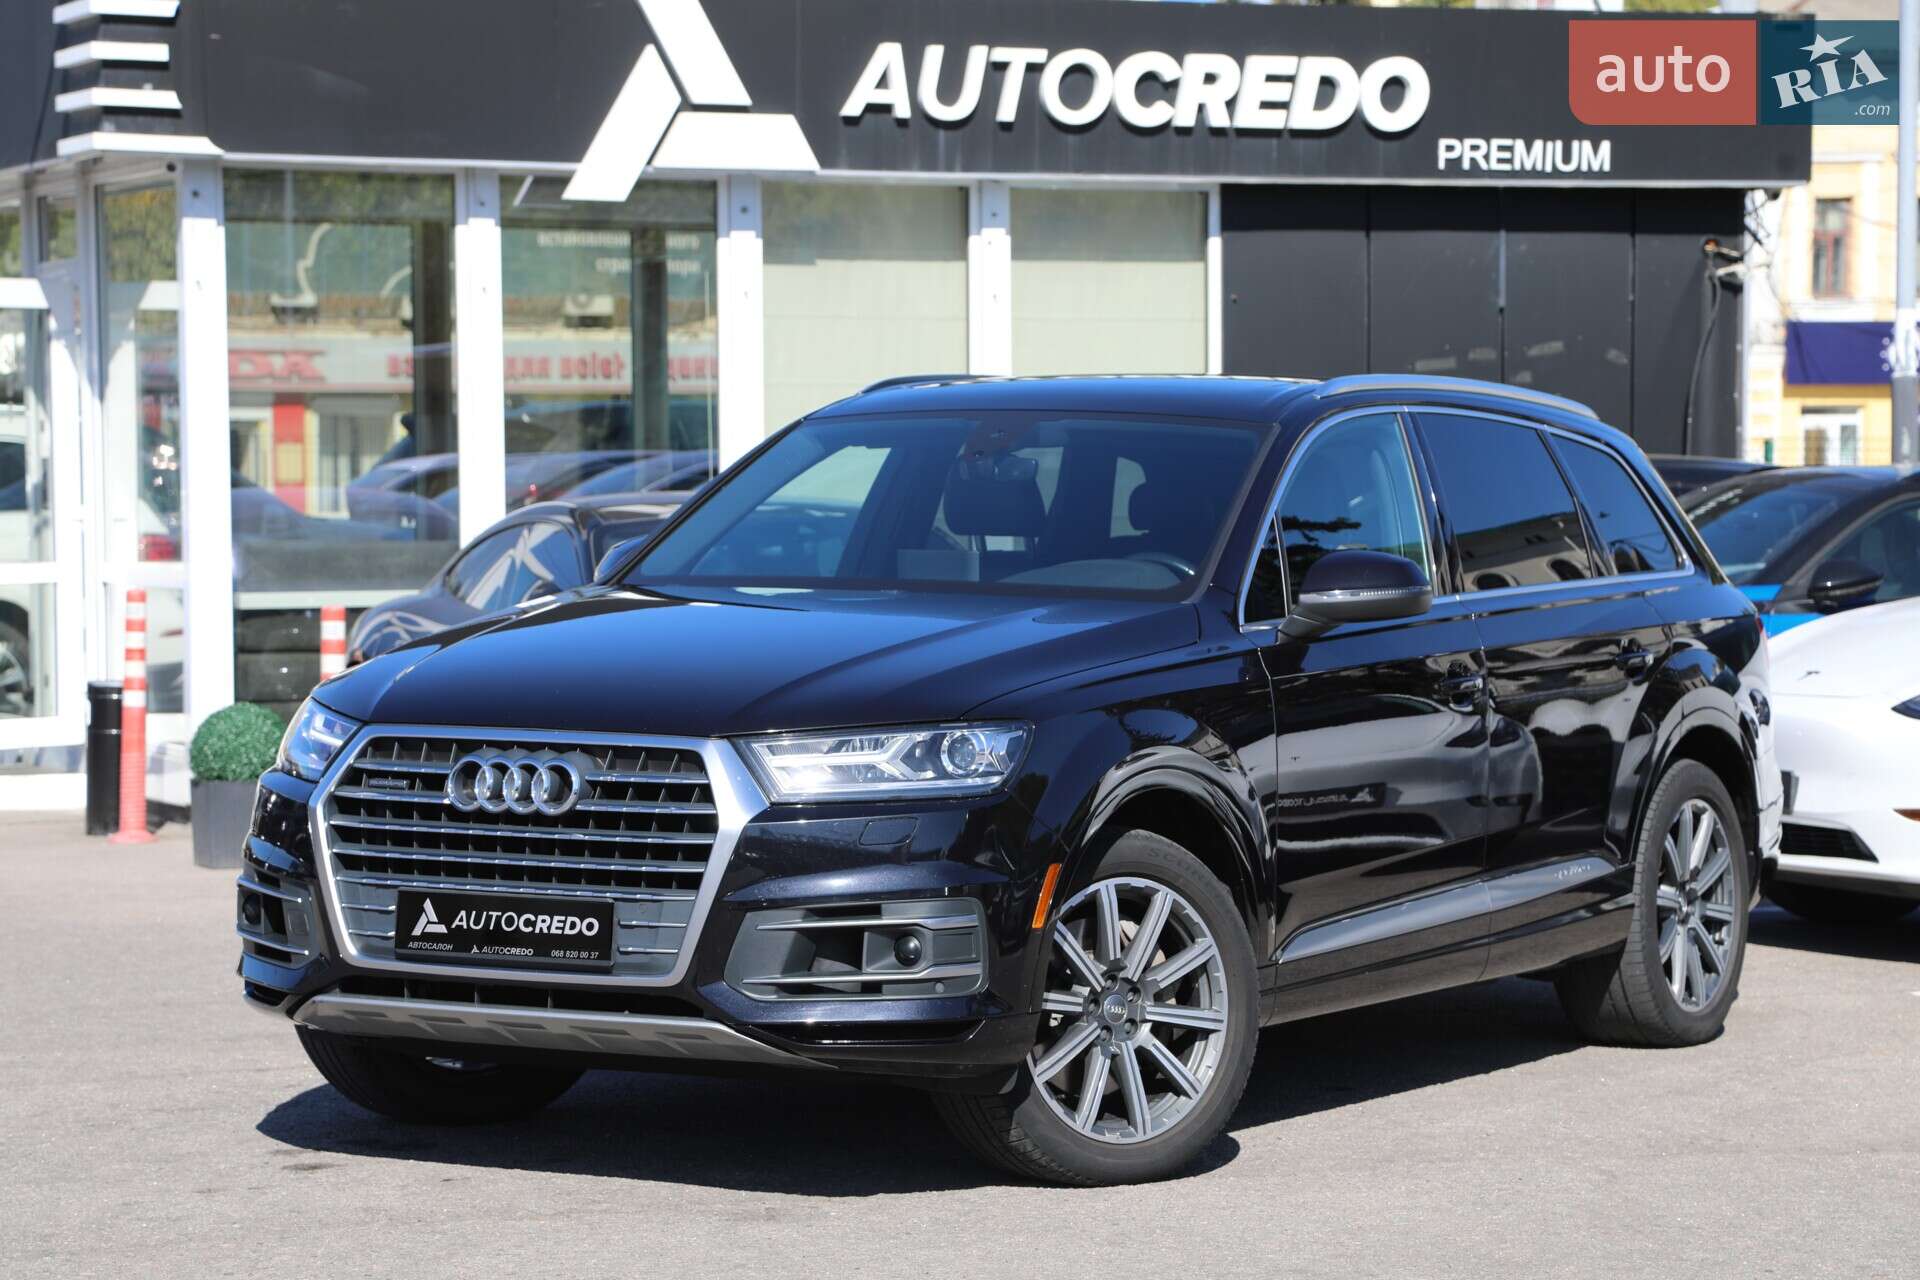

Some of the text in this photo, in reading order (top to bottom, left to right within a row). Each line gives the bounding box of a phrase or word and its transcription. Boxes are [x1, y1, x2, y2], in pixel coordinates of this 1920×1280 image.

[840, 42, 1431, 134] AUTOCREDO
[1436, 138, 1612, 173] PREMIUM
[451, 909, 600, 937] AUTOCREDO
[407, 941, 453, 951] АВТОСАЛОН
[481, 945, 534, 956] AUTOCREDO
[551, 950, 599, 960] 068 820 00 37
